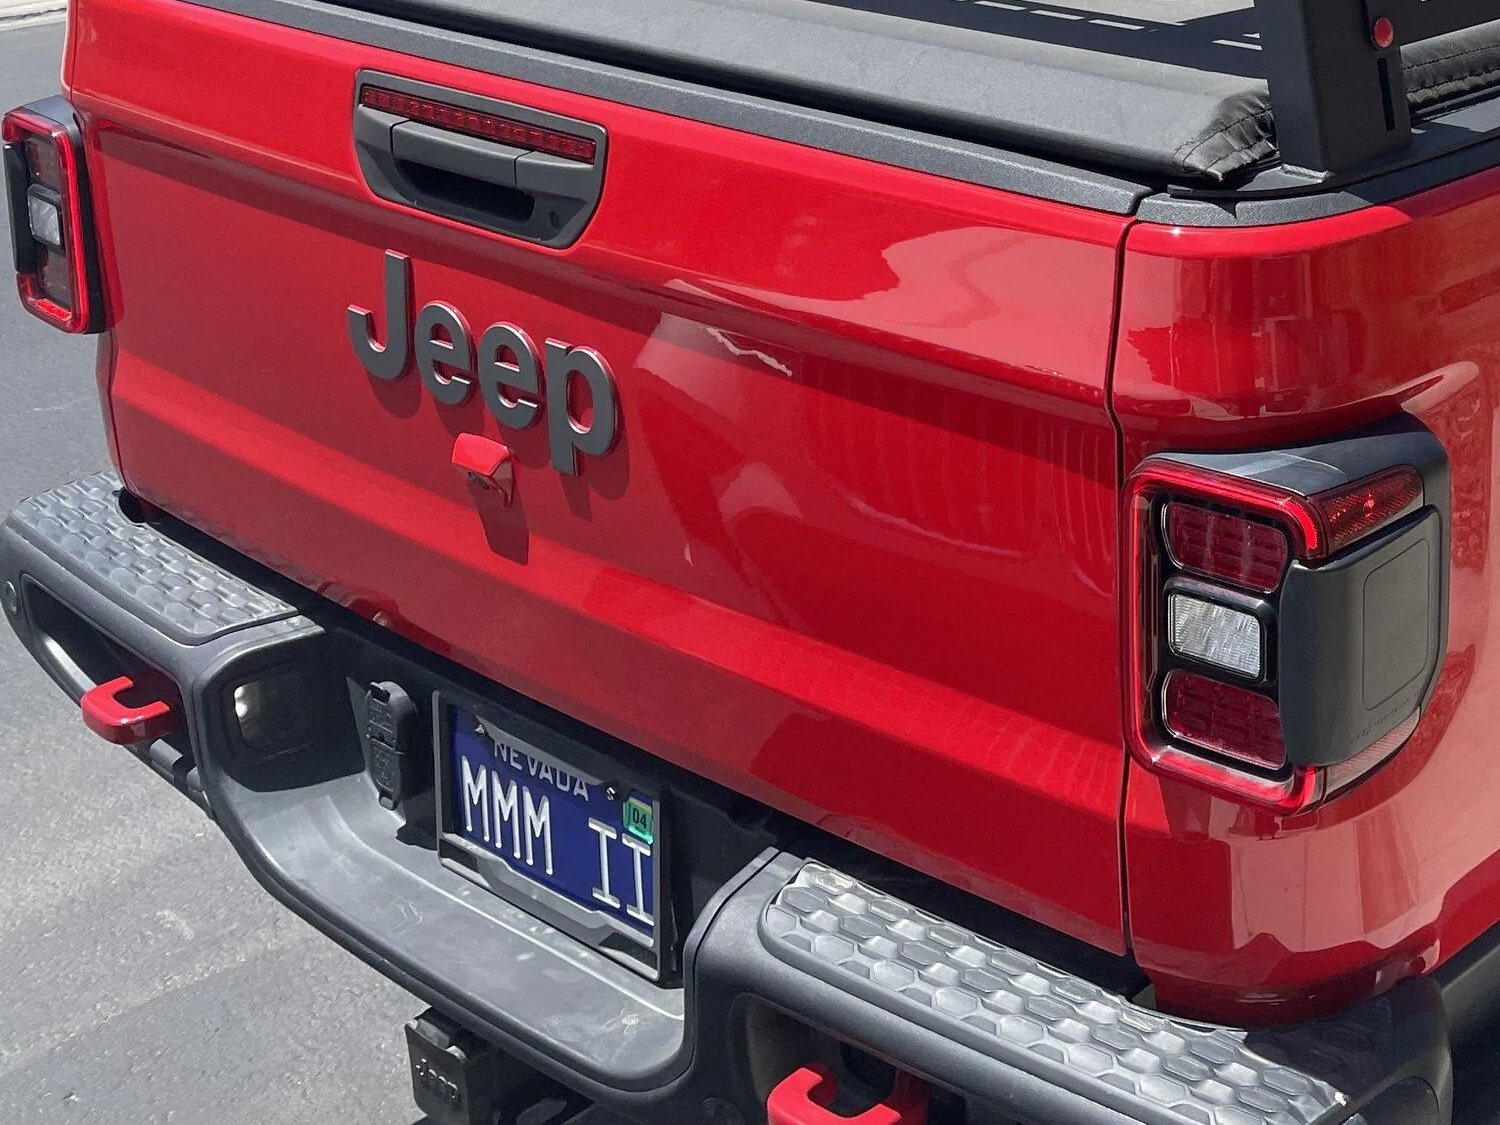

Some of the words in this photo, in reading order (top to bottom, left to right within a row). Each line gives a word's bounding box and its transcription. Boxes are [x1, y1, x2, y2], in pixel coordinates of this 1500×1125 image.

[347, 248, 619, 477] Jeep
[461, 755, 553, 875] MMM
[492, 740, 590, 802] NEVADA
[632, 807, 647, 829] 04
